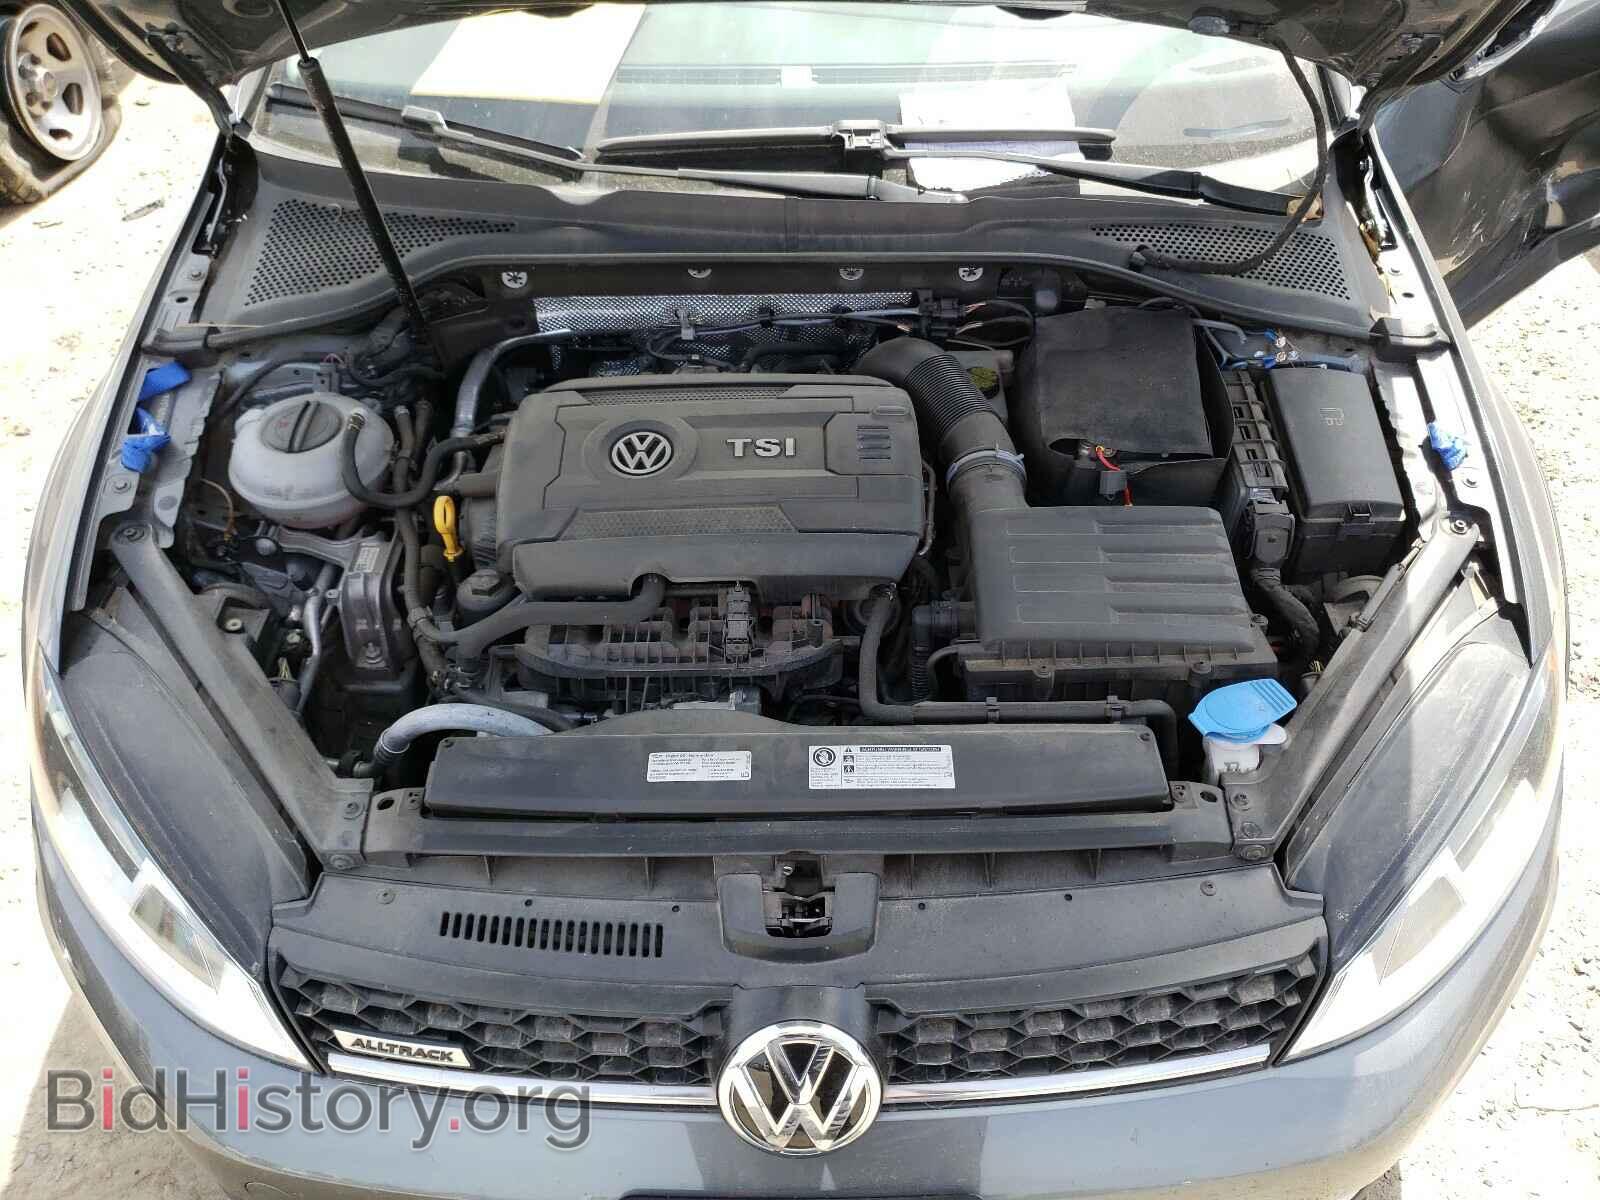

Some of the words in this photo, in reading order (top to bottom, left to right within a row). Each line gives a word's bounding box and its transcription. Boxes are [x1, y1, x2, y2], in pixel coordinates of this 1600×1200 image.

[611, 431, 673, 474] VW
[726, 437, 797, 458] TSI
[351, 1038, 455, 1062] ALLTRACK
[718, 1021, 881, 1156] VW
